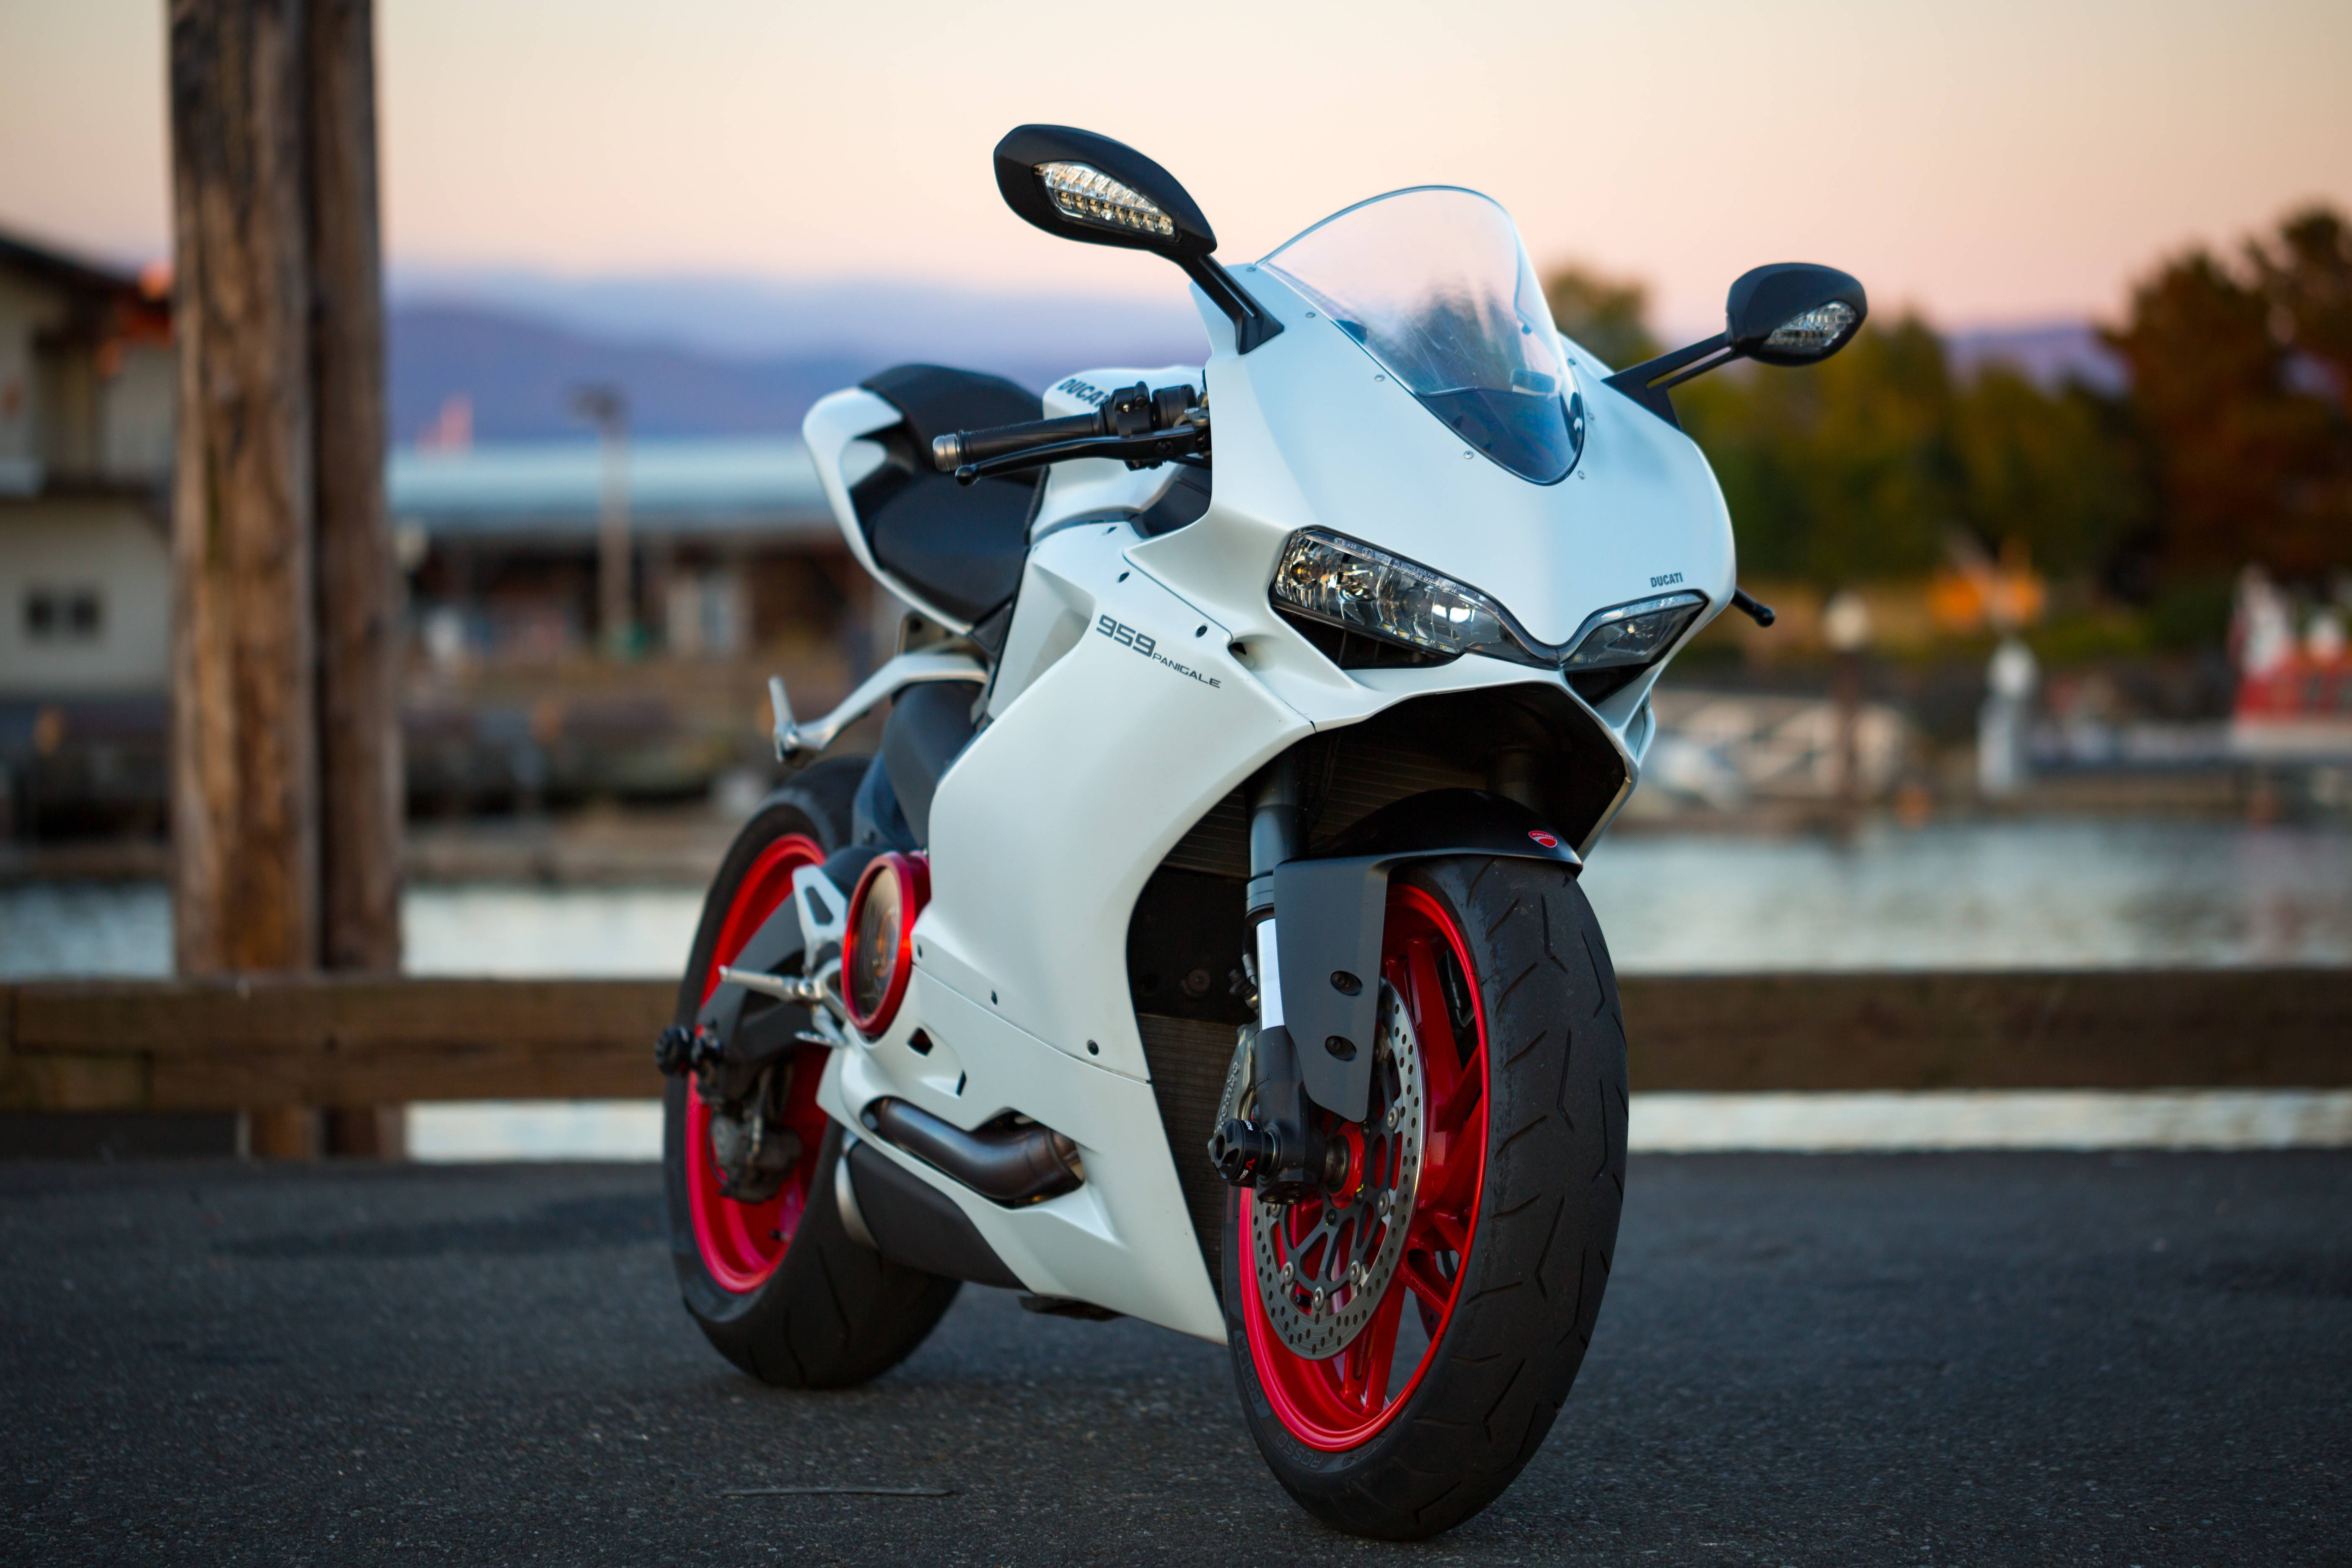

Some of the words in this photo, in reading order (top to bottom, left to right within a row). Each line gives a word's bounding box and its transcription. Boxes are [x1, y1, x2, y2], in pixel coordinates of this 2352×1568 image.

[1650, 573, 1683, 588] DUCATI
[1096, 614, 1156, 658] 959
[1152, 652, 1221, 688] PANIGALE
[1236, 1335, 1262, 1405] CORSA
[1275, 1432, 1324, 1469] ROSSO
